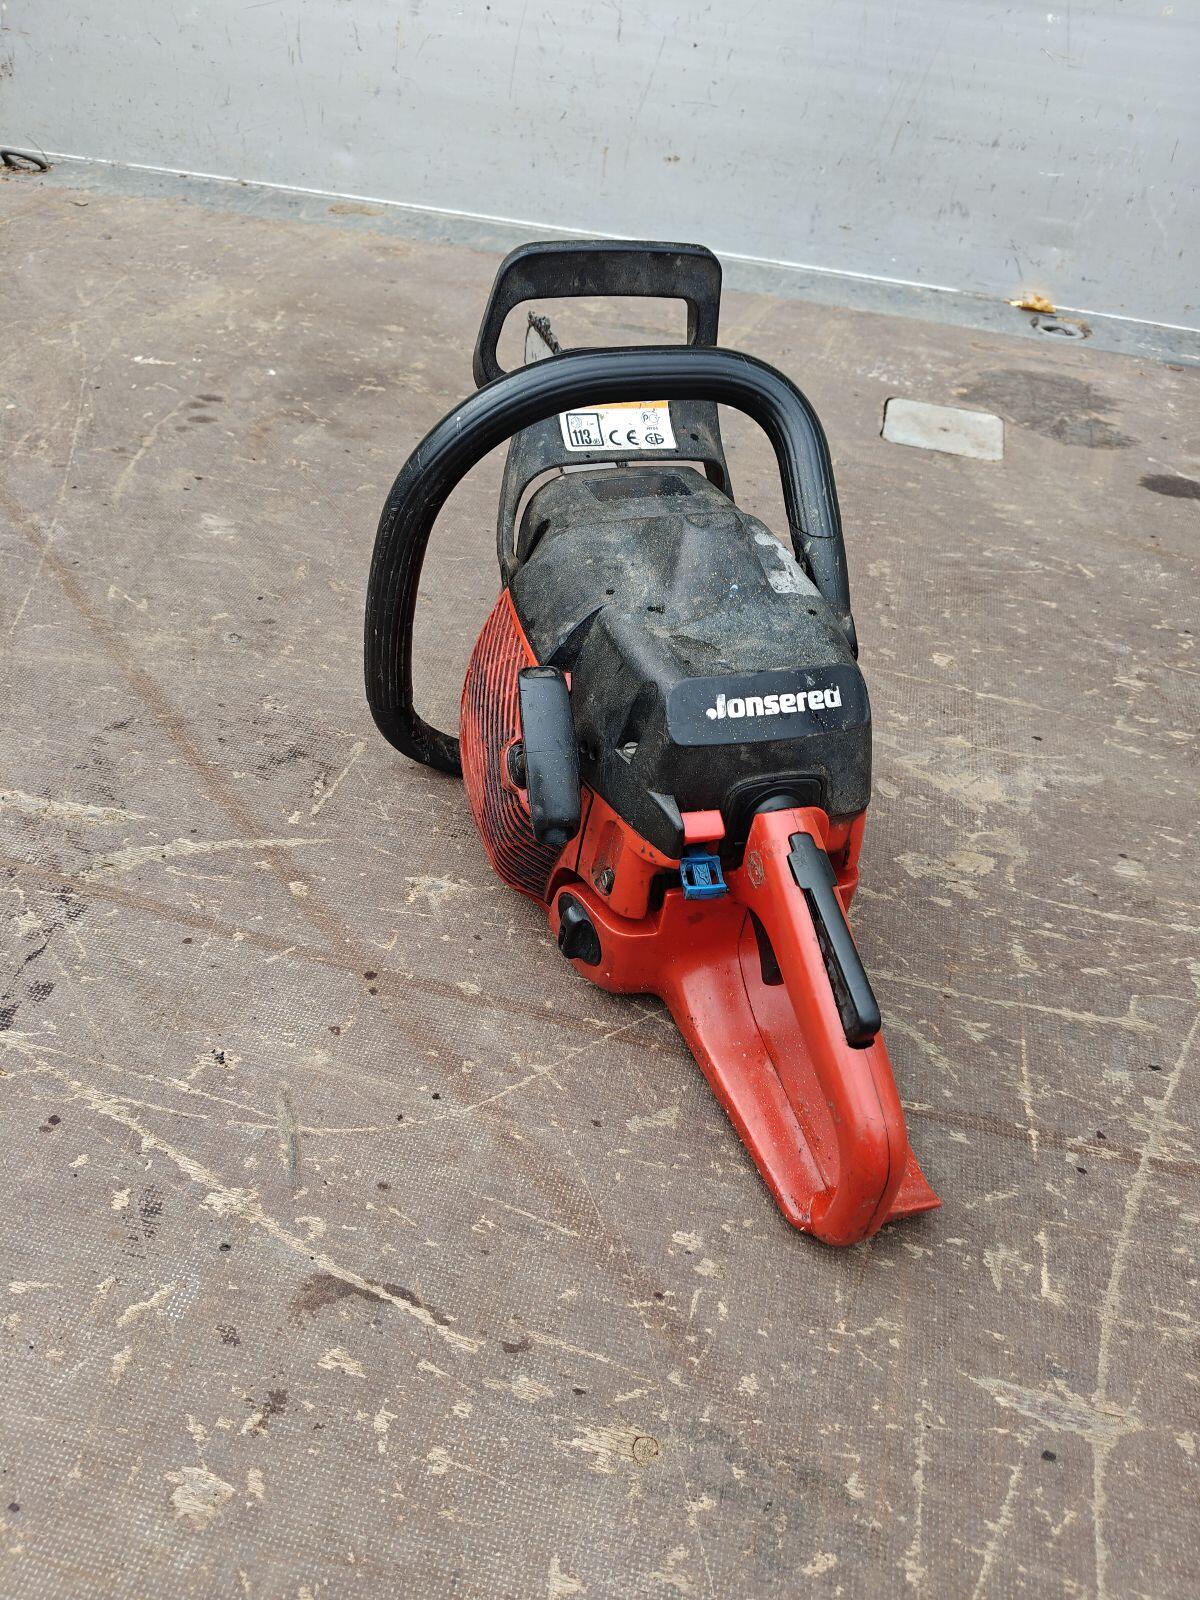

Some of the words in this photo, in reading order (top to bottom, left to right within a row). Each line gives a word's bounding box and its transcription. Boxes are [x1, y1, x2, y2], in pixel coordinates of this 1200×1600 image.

[573, 429, 591, 444] 113
[609, 430, 640, 445] CE
[705, 684, 842, 720] Jonsered
